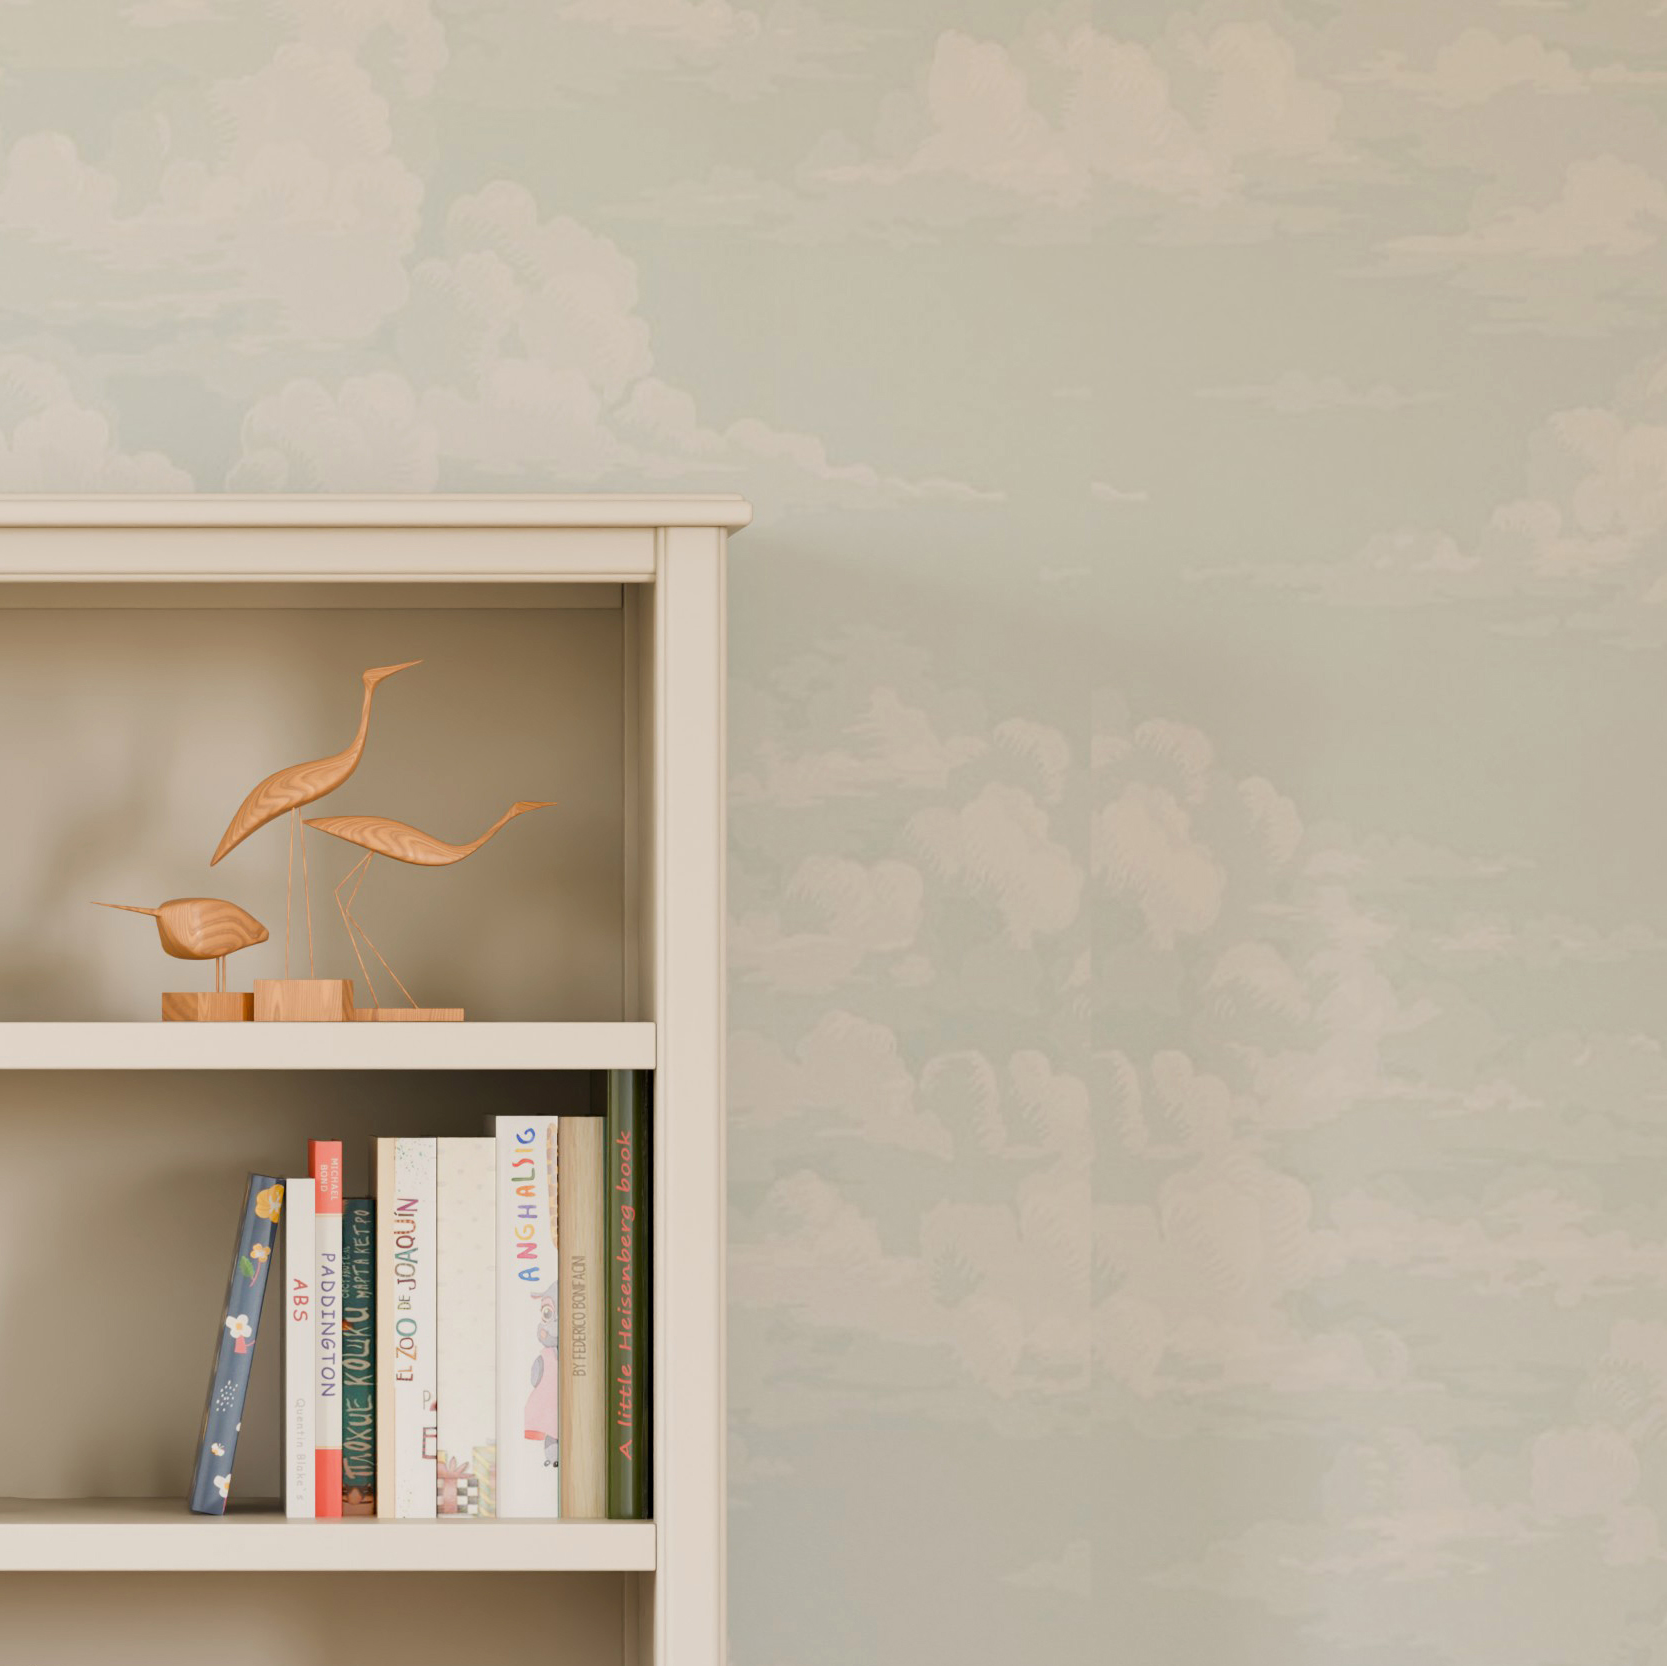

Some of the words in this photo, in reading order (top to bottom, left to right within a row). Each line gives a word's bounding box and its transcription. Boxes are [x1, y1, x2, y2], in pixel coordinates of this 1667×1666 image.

[330, 1158, 339, 1200] MICHAEL
[616, 1131, 632, 1193] book
[511, 1128, 540, 1282] ANGHALSIG
[353, 1209, 371, 1253] КЕТРО
[393, 1198, 419, 1291] JOAQUÍN
[293, 1279, 309, 1321] ABS
[352, 1259, 372, 1298] МАРТА
[616, 1205, 635, 1350] Heisenberg
[320, 1253, 336, 1397] PADDINGTON
[397, 1295, 412, 1310] DE
[342, 1307, 374, 1386] КОШКИ
[572, 1312, 586, 1359] FEDERICO
[396, 1366, 413, 1381] EL
[572, 1363, 586, 1377] BY
[617, 1364, 632, 1426] little
[295, 1398, 306, 1448] Quentin
[343, 1395, 374, 1479] ПЛОХИЕ
[620, 1440, 632, 1460] A
